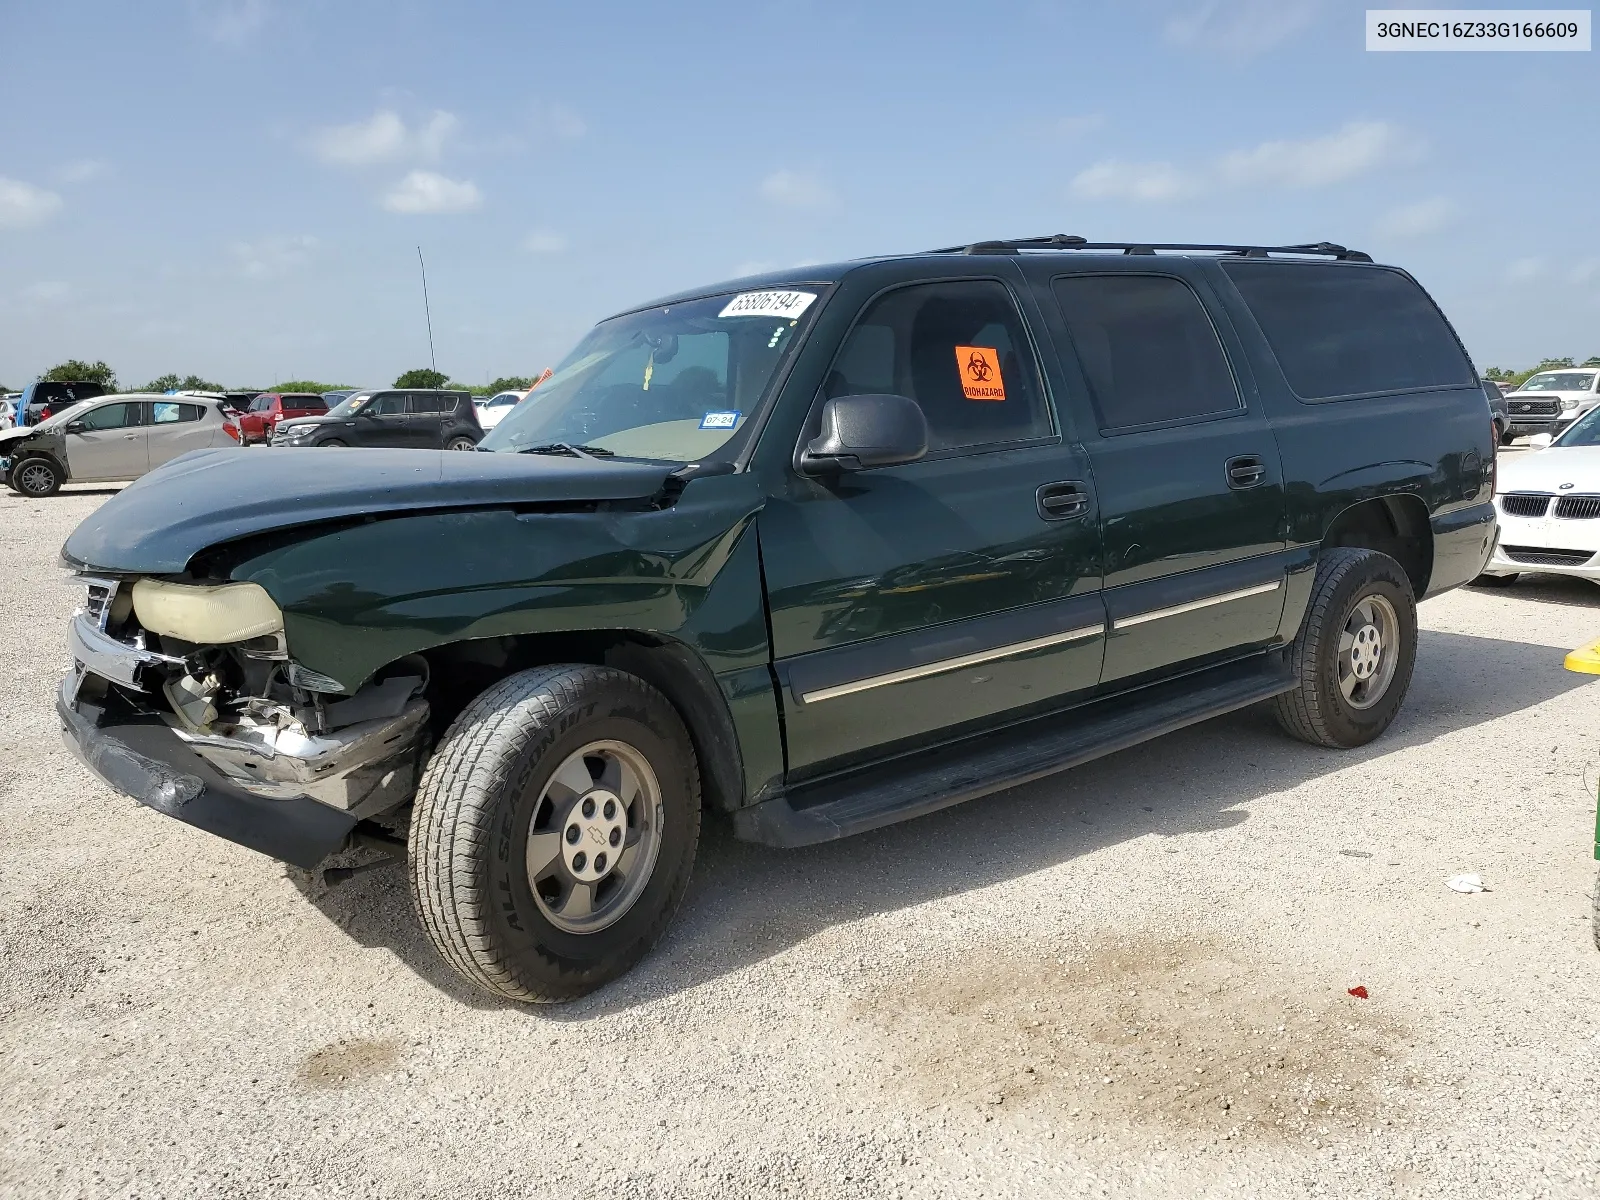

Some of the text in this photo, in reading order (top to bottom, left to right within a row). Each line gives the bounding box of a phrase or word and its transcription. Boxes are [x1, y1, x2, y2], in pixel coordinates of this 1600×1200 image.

[964, 386, 1003, 397] BIOHAZARD
[706, 416, 733, 424] 07-24
[499, 728, 555, 863] SEASON
[499, 872, 524, 932] ALL
